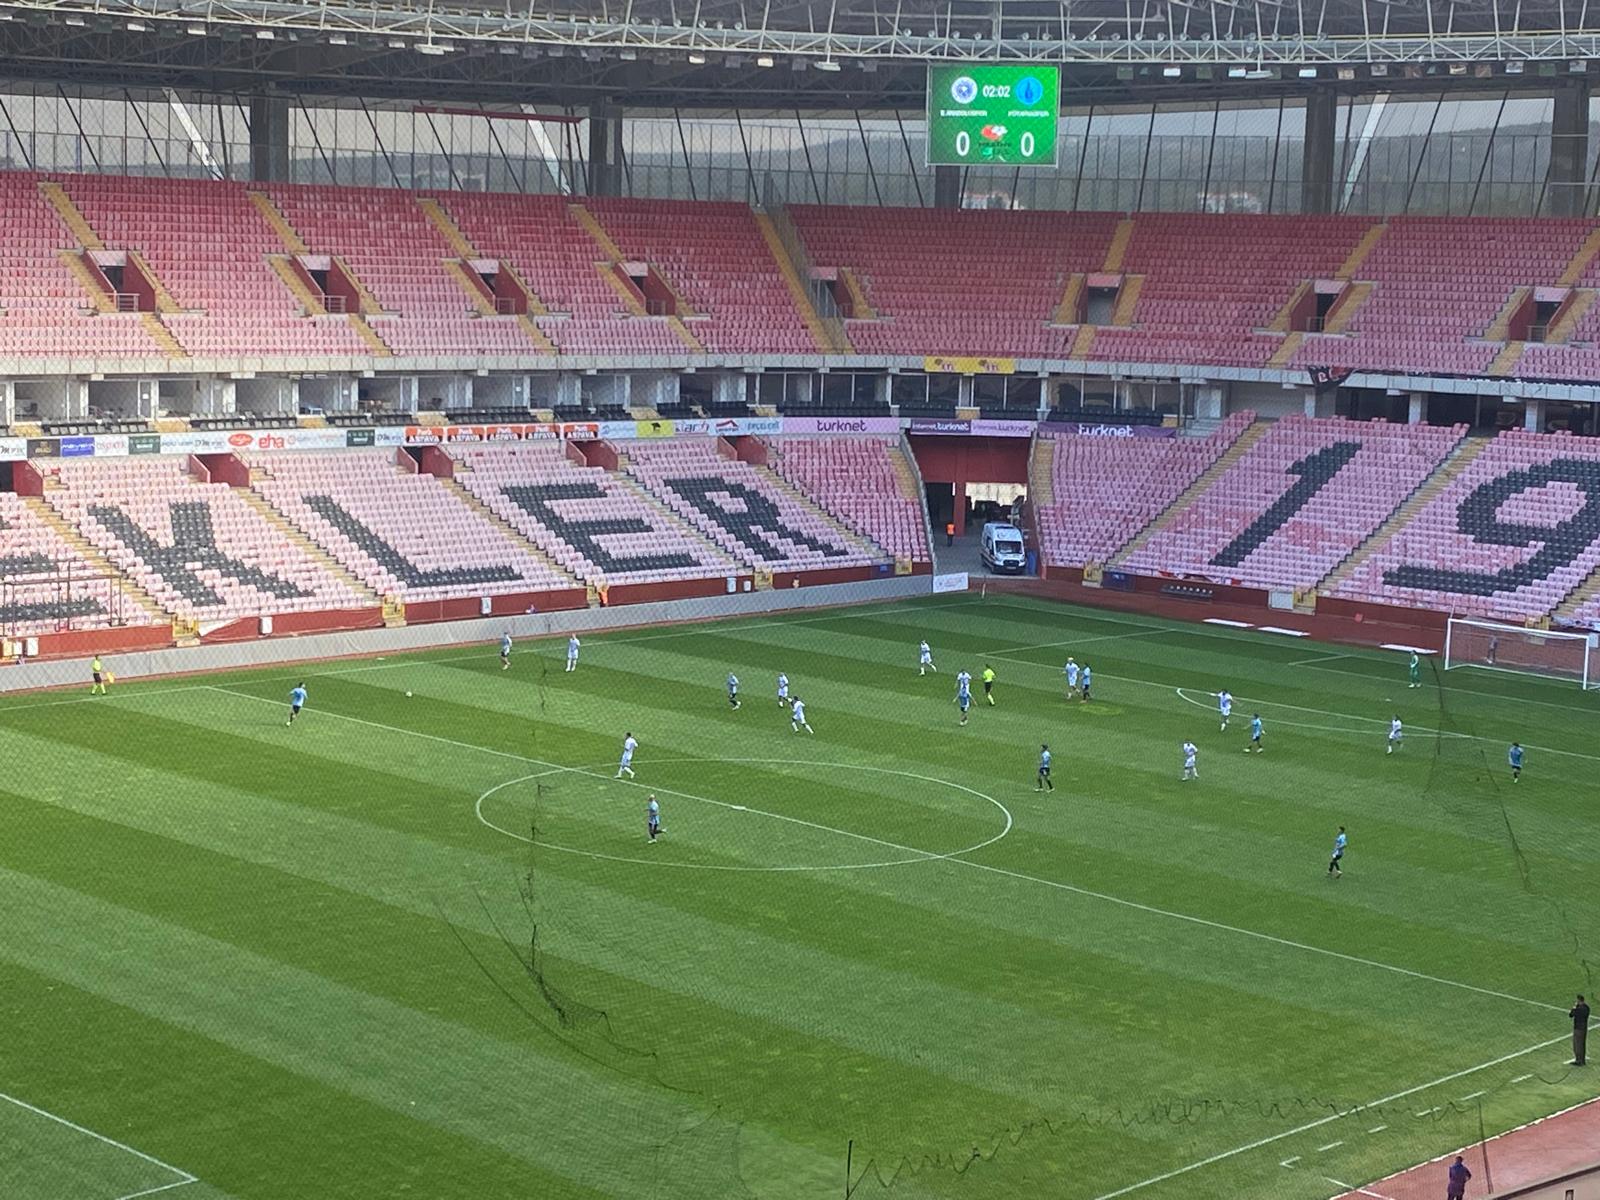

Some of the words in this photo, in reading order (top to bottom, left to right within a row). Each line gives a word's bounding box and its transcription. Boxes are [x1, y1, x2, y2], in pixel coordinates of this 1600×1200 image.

[982, 85, 1010, 98] 02:02
[956, 131, 970, 156] 0
[1020, 131, 1035, 157] 0
[817, 419, 867, 432] turknet
[936, 422, 969, 431] turknet
[1078, 423, 1134, 437] turknet
[258, 433, 285, 448] eha
